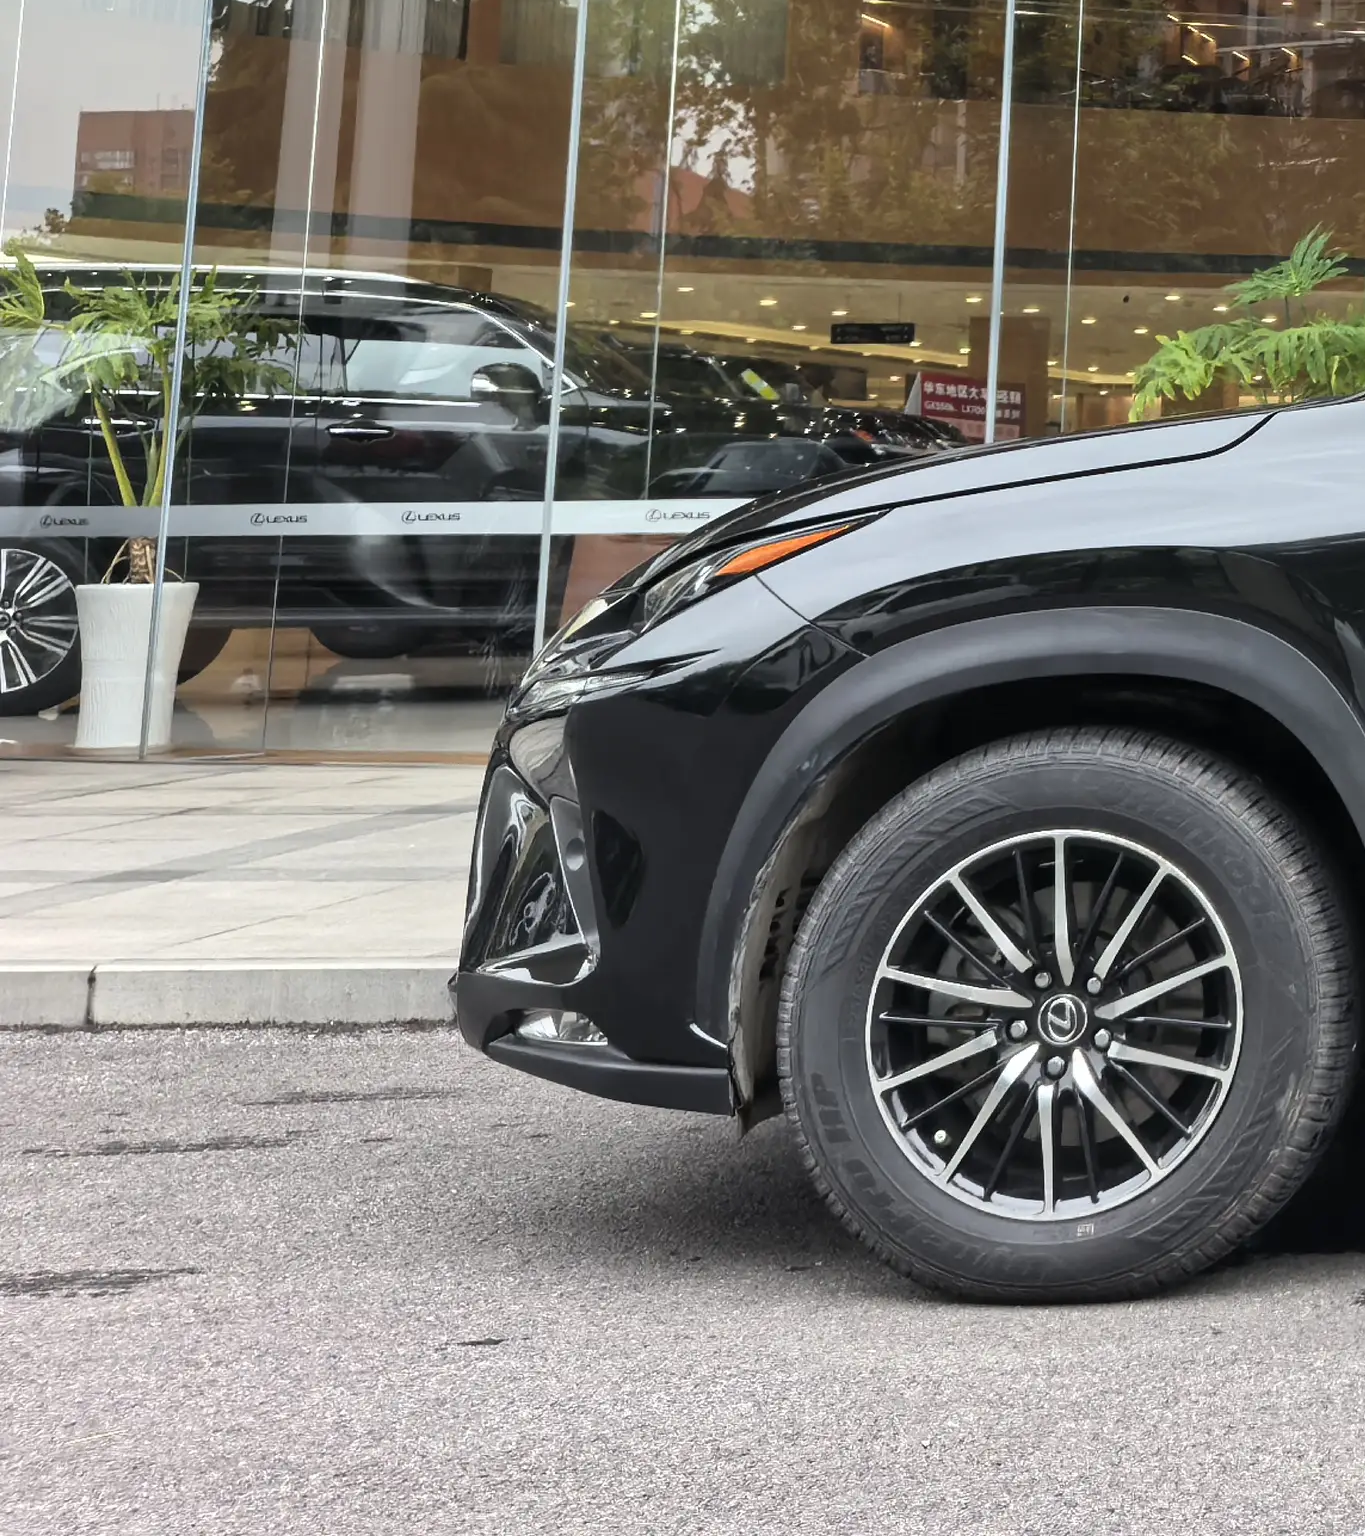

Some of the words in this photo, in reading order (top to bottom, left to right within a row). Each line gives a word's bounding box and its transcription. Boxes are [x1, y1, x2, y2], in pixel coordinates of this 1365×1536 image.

[265, 514, 308, 524] LEXUS
[417, 512, 461, 522] LEXUS
[662, 511, 710, 521] LEXUS
[53, 518, 90, 526] LEXUS
